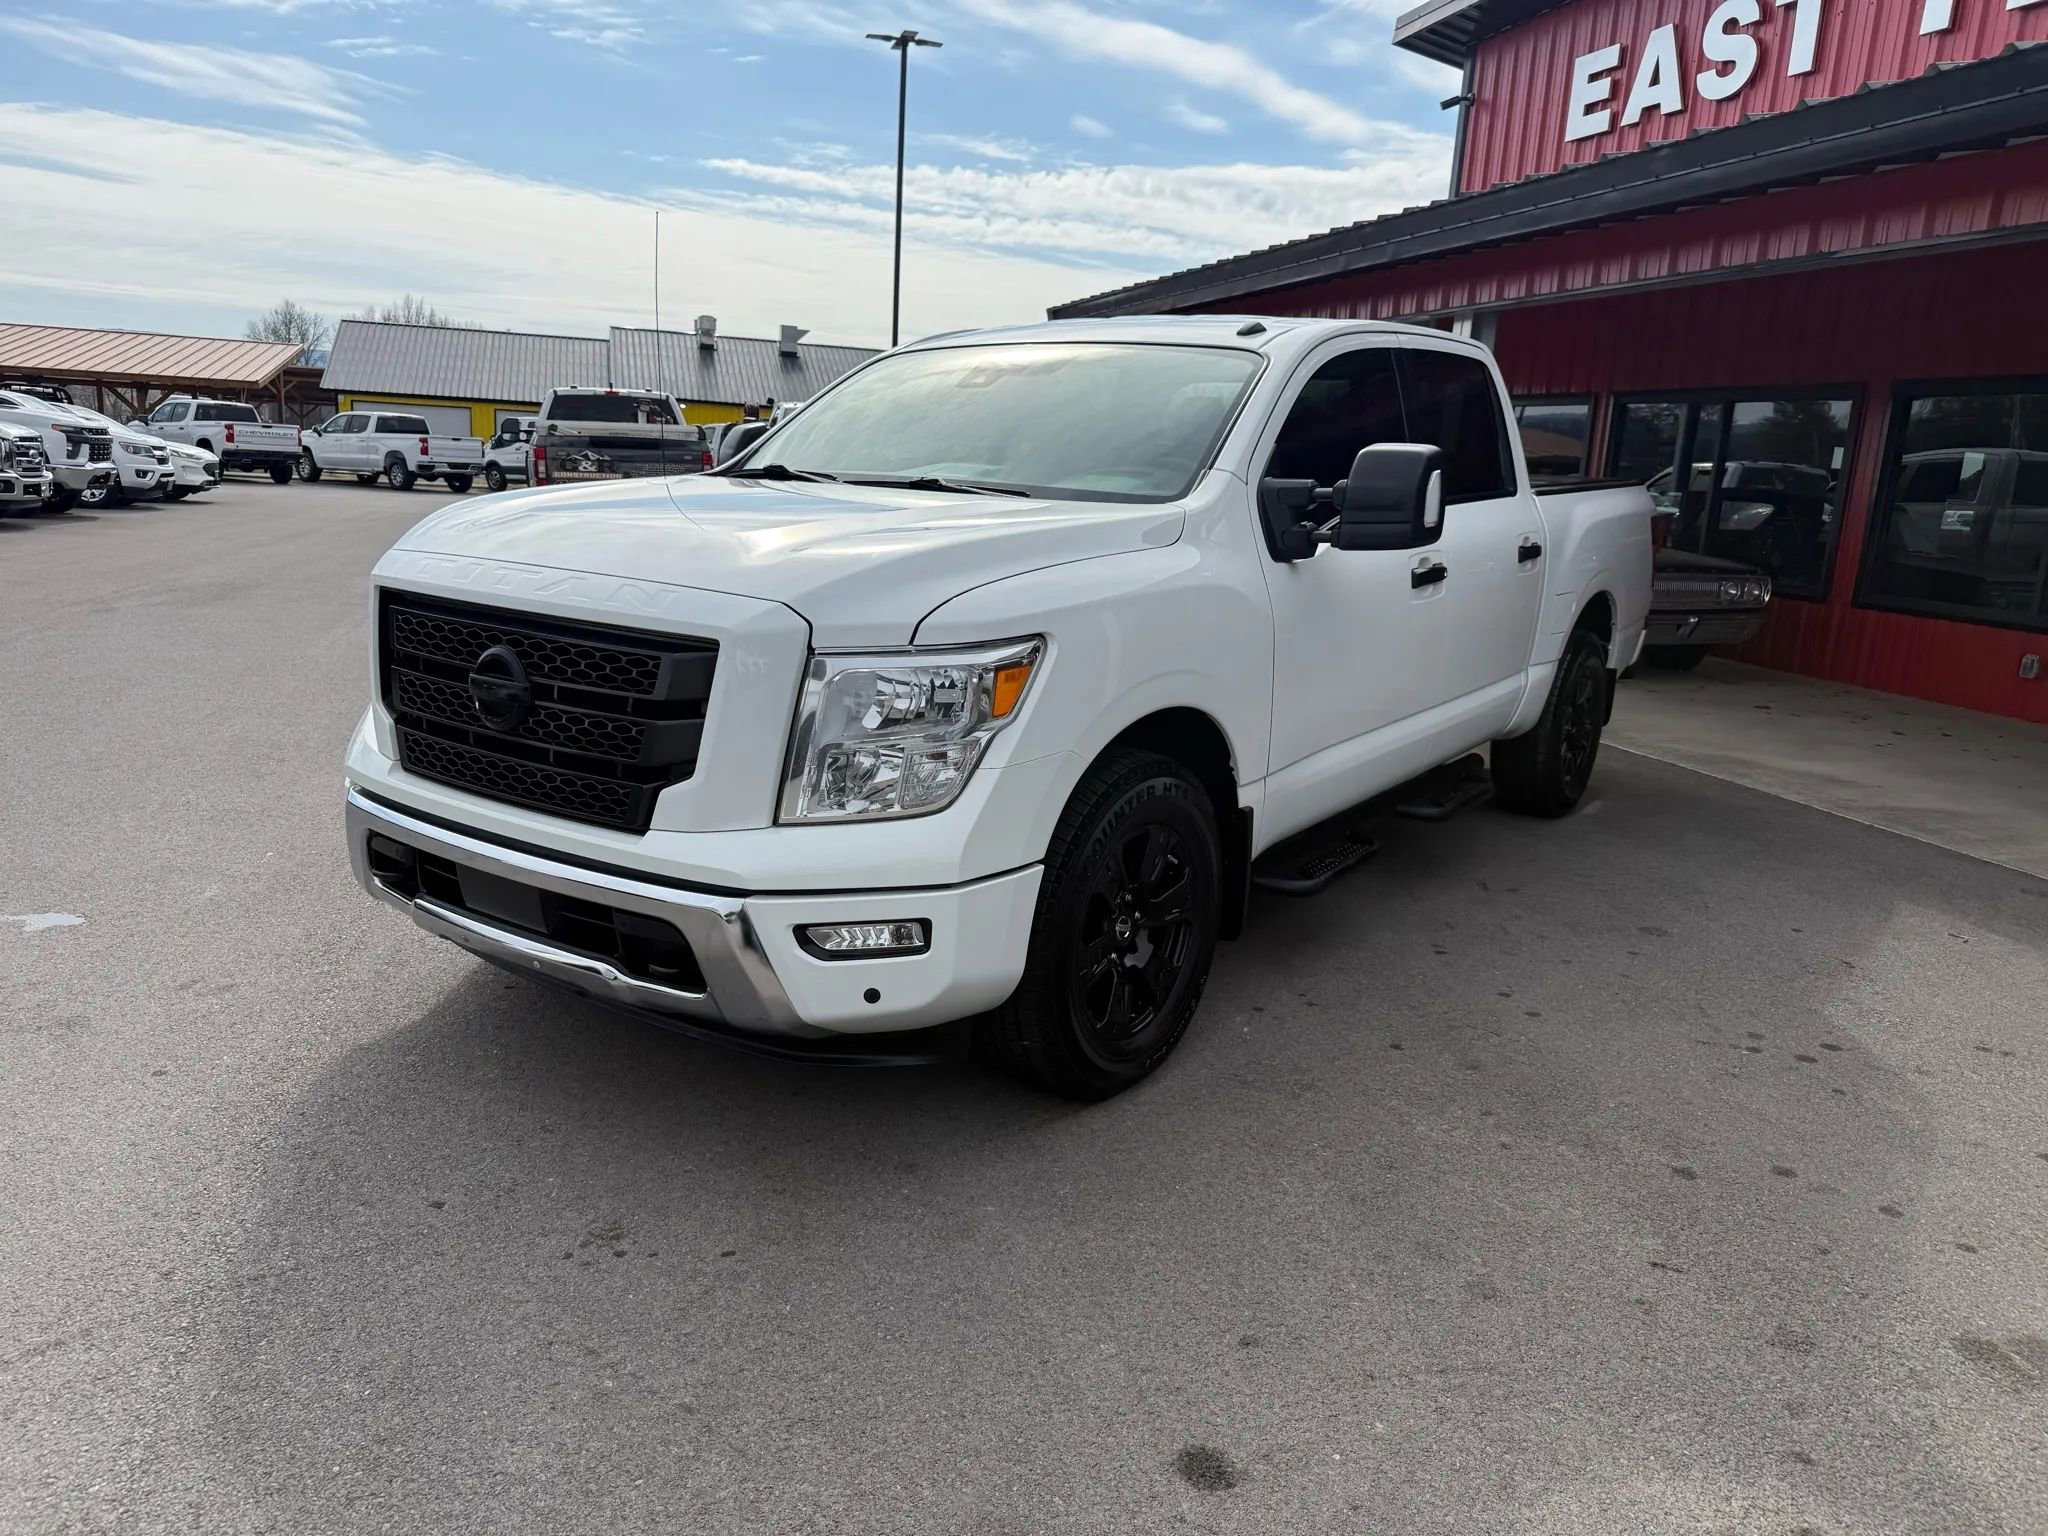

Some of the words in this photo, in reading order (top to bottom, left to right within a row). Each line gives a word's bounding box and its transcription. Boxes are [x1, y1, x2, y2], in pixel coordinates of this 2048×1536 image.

[1565, 0, 1824, 142] EAST
[238, 429, 294, 437] CHEVROLET
[553, 471, 622, 479] CONSTRUCTION
[416, 557, 680, 612] TITAN
